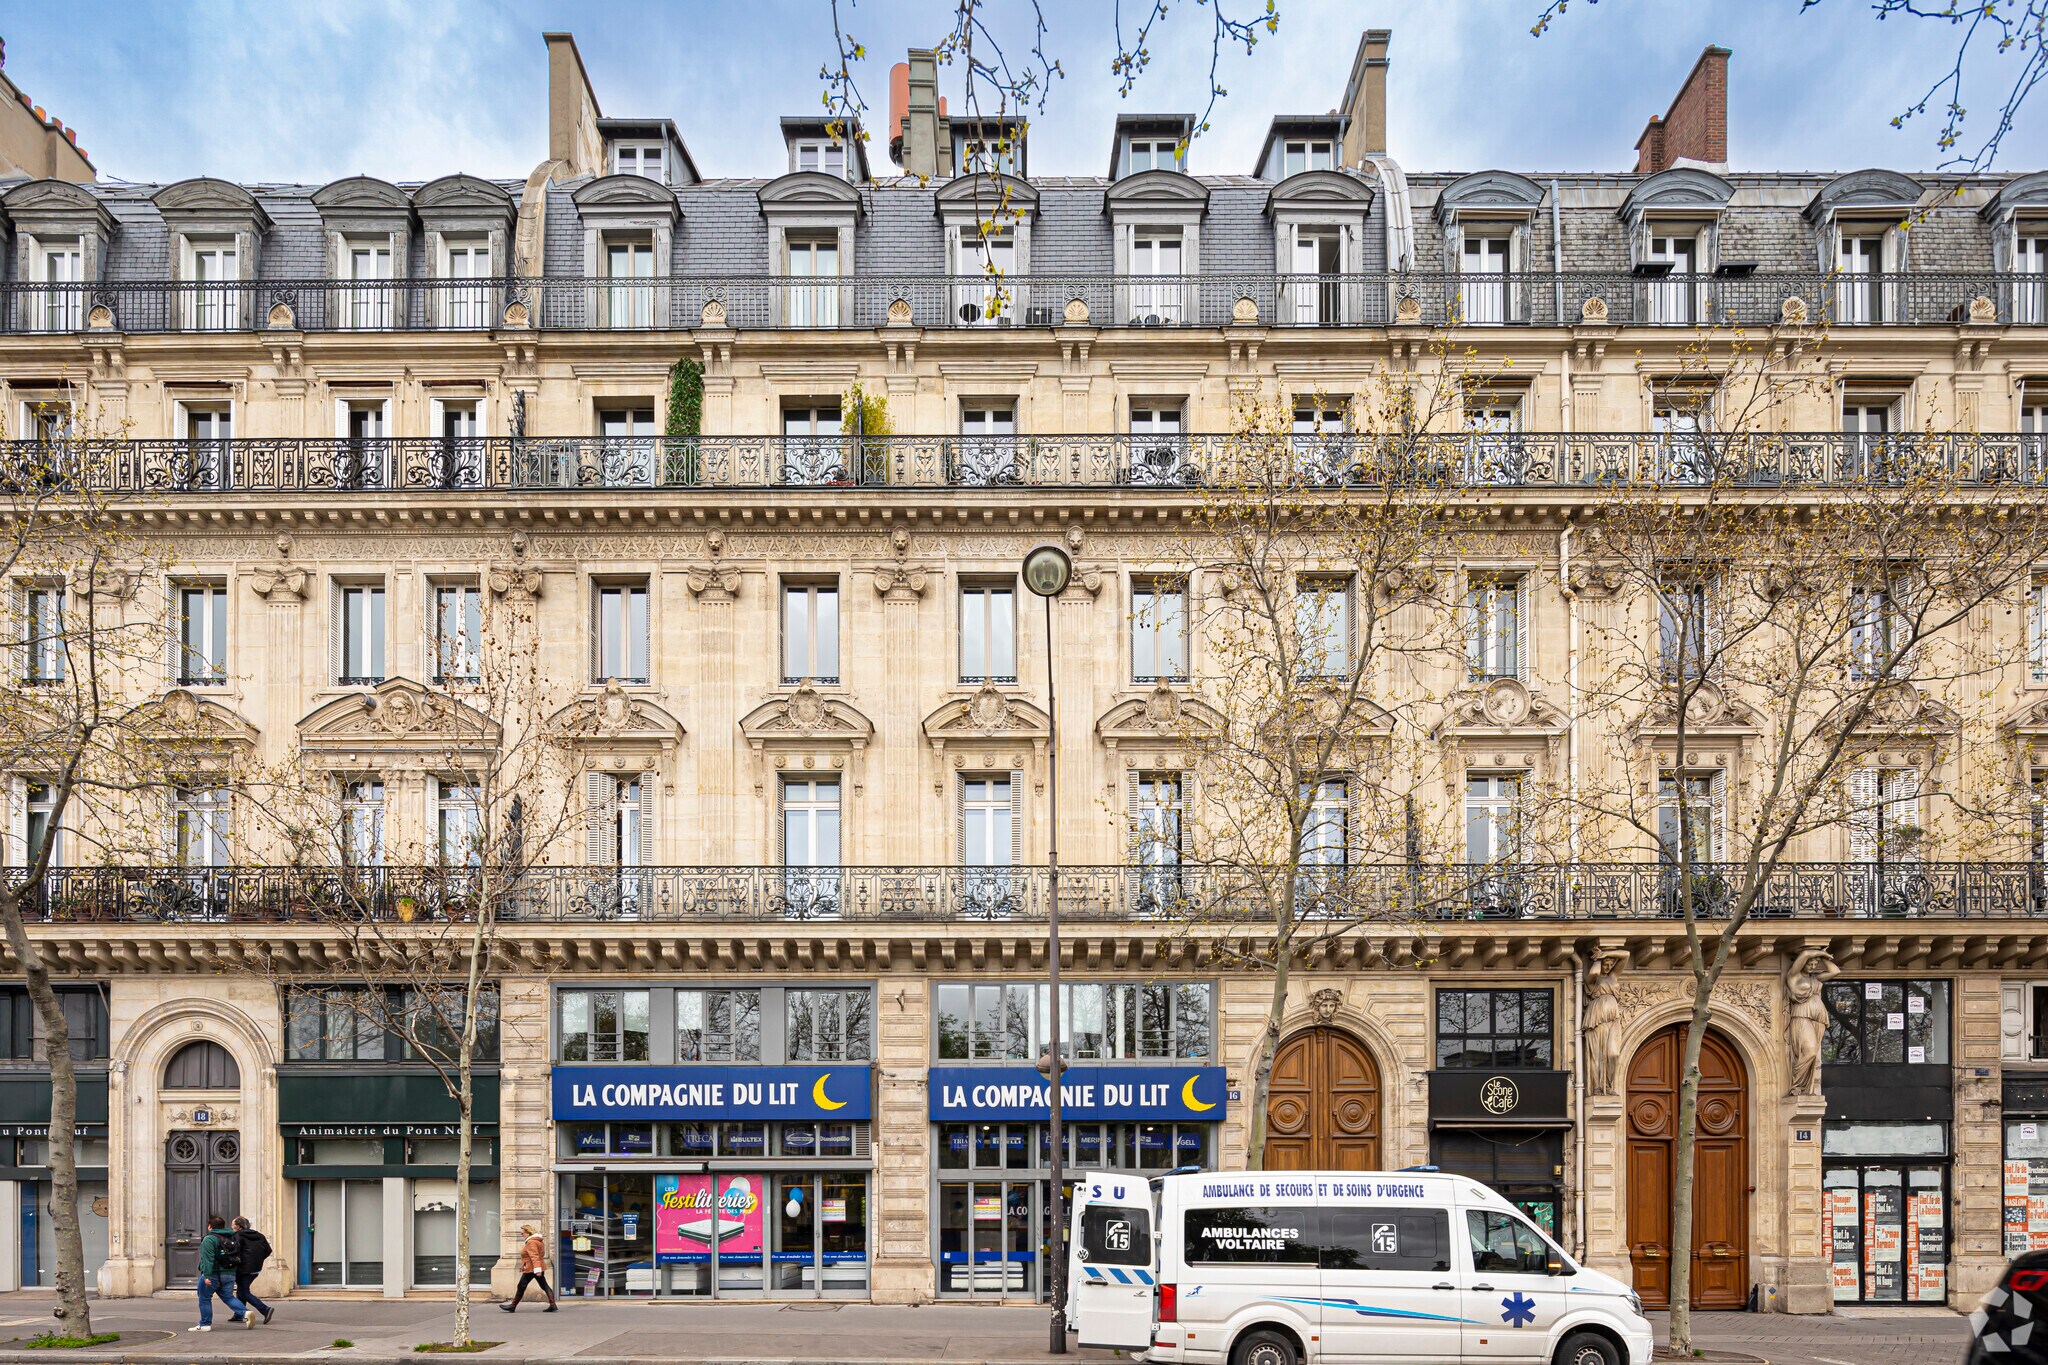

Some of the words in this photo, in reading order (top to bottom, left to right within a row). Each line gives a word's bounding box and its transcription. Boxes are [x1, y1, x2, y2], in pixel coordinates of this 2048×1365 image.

[1493, 1079, 1501, 1088] Le
[572, 1084, 597, 1107] LA
[601, 1083, 724, 1107] COMPAGNIE
[732, 1082, 762, 1105] DU
[768, 1082, 799, 1105] LIT
[1487, 1083, 1513, 1096] Scone
[943, 1085, 968, 1108] LA
[1103, 1084, 1133, 1106] DU
[1139, 1084, 1170, 1106] LIT
[1229, 1091, 1238, 1100] 16
[1492, 1095, 1513, 1112] Café
[197, 1112, 206, 1121] 18
[17, 1126, 48, 1136] Pont
[74, 1126, 89, 1136] uf
[299, 1125, 377, 1136] Animalerie
[383, 1125, 399, 1136] du
[406, 1125, 438, 1136] Pont
[444, 1125, 480, 1136] Nef
[1799, 1131, 1809, 1140] 14
[686, 1134, 714, 1144] TRECA
[1176, 1135, 1196, 1146] GELL
[1202, 1184, 1255, 1198] AMBULANCE
[1260, 1183, 1271, 1197] DE
[1275, 1183, 1313, 1197] SECOURS
[1318, 1183, 1328, 1197] ET
[1333, 1184, 1344, 1197] DE
[1346, 1184, 1372, 1197] SOINS
[1377, 1184, 1425, 1198] D'URGENCE
[1201, 1227, 1299, 1239] AMBULANCES
[1110, 1233, 1129, 1249] 15
[1215, 1239, 1286, 1250] VOLTAIRE
[1377, 1236, 1396, 1252] 15
